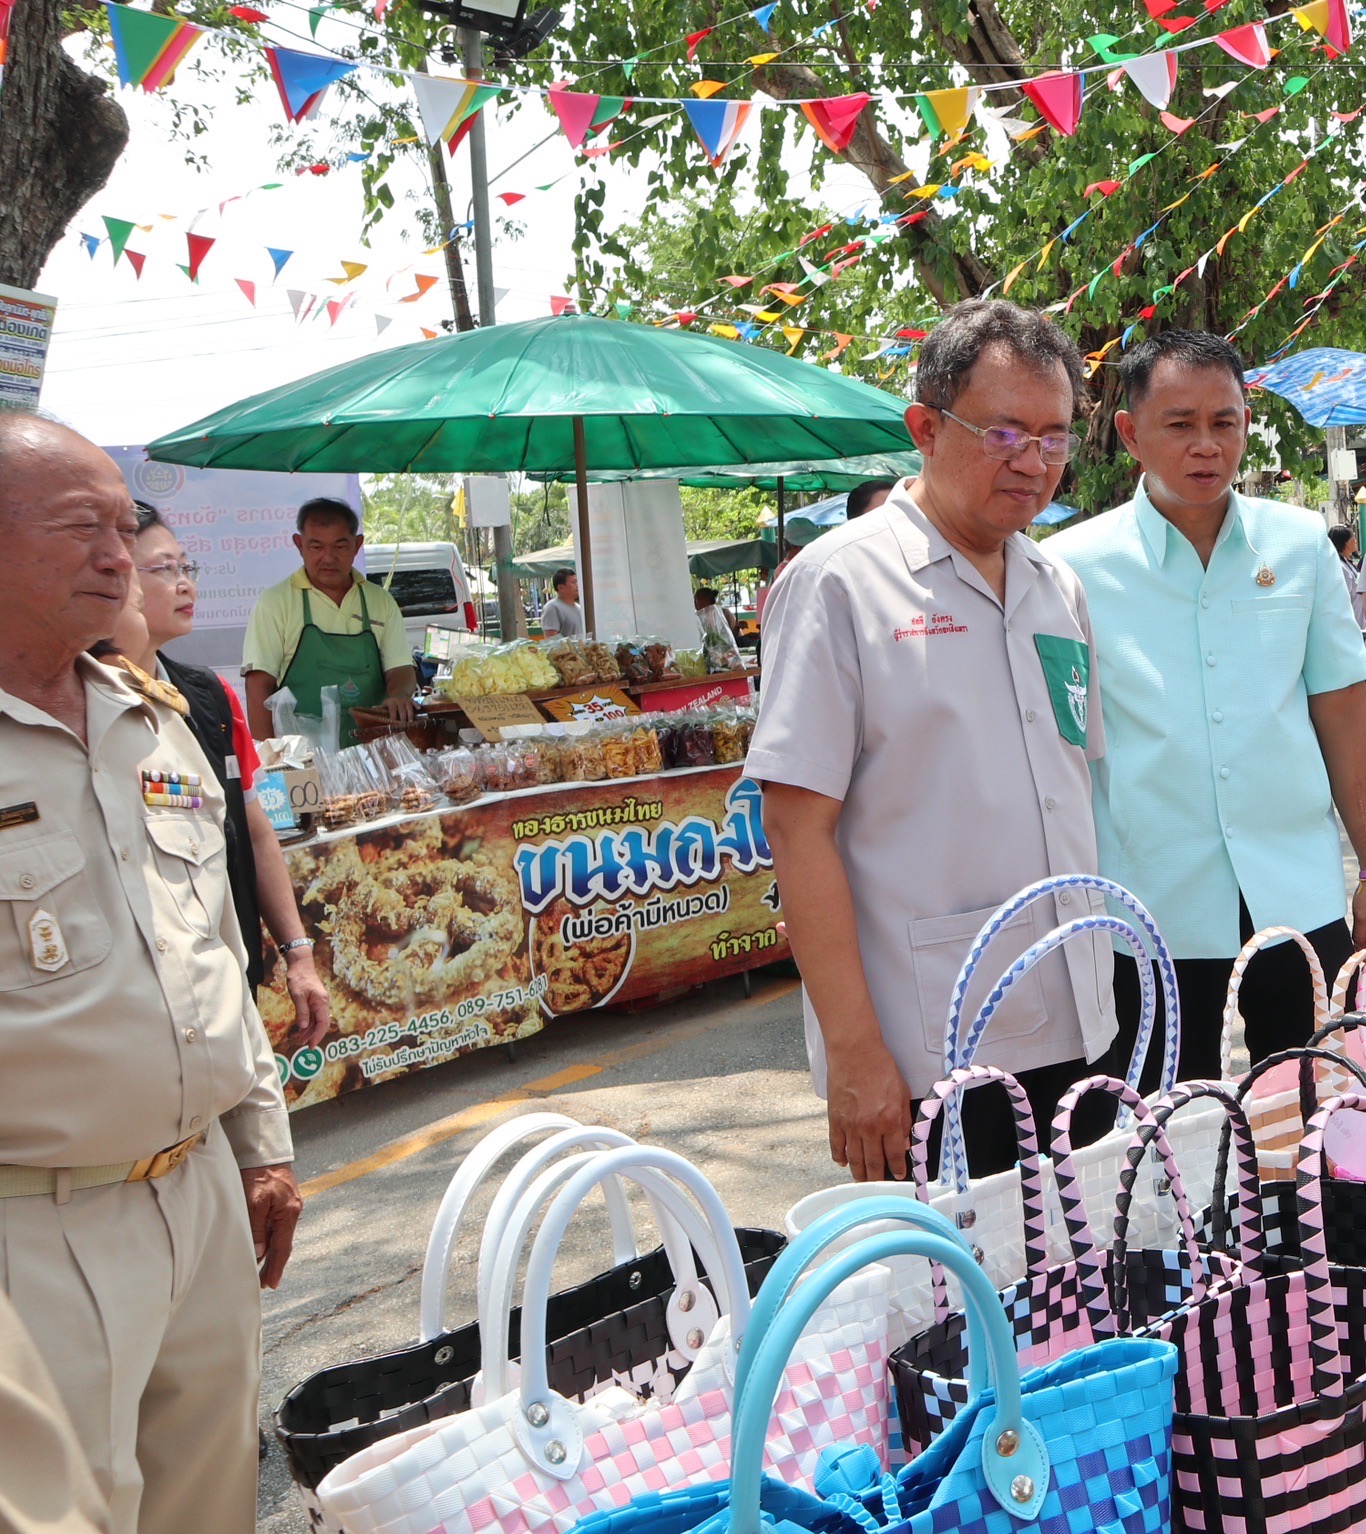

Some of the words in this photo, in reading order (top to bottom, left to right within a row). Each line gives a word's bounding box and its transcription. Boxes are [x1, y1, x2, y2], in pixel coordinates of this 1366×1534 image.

[583, 701, 604, 714] 35
[604, 709, 625, 721] 100
[688, 686, 723, 709] ZEALAND
[260, 791, 278, 807] 35
[512, 799, 663, 840] ทองธารขนมไทย
[515, 777, 774, 911] ขนมกงโ
[563, 884, 729, 944] (พ่อค้ามีหนวด)
[710, 928, 777, 960] ทำจาก
[326, 1009, 455, 1060] 083-225-4456,
[458, 974, 549, 1018] 089-751-6281
[361, 1024, 489, 1077] ไม่รับปรึกษาปัญหาหัวใจ
